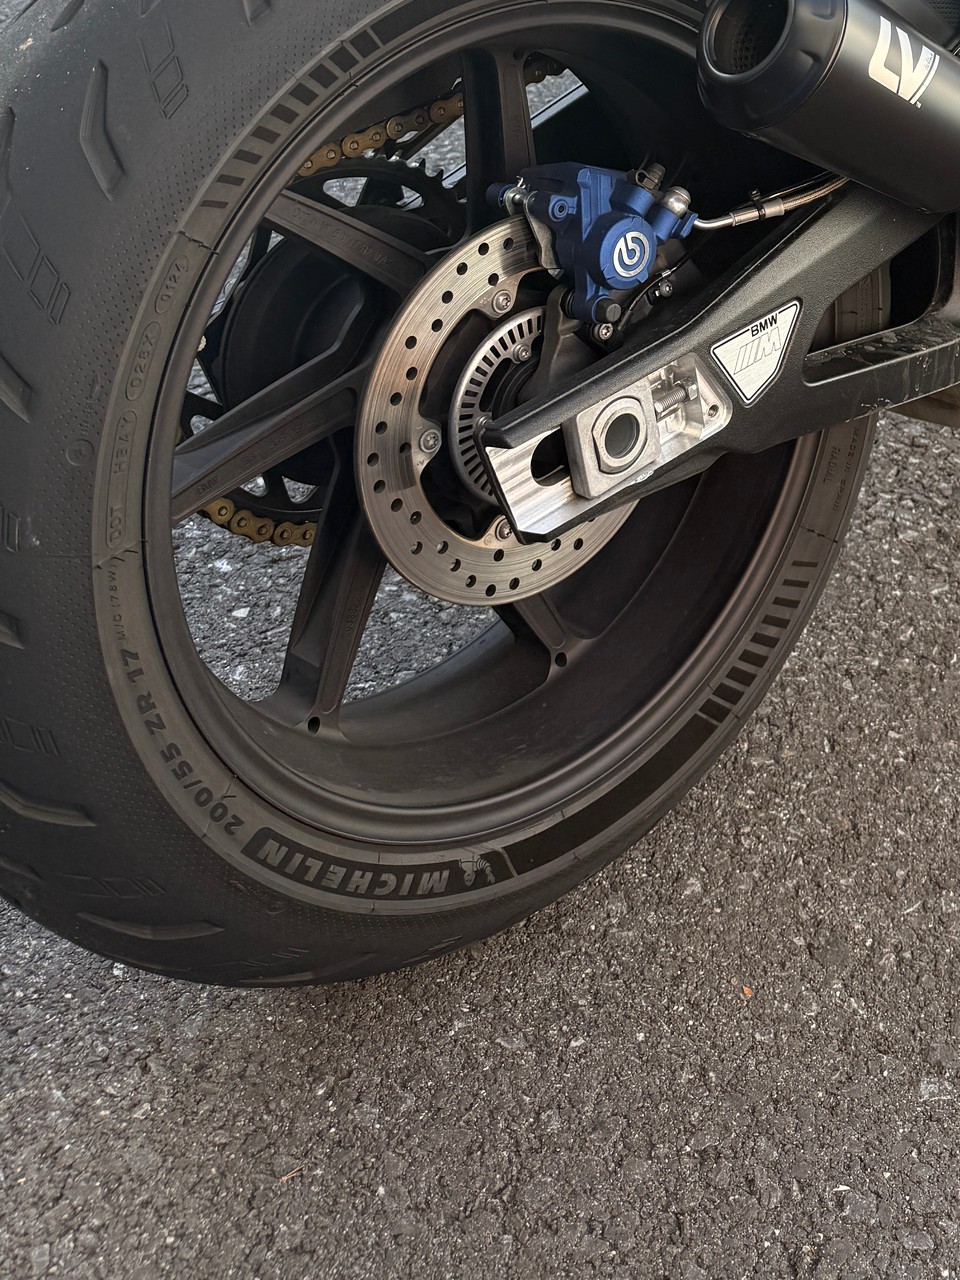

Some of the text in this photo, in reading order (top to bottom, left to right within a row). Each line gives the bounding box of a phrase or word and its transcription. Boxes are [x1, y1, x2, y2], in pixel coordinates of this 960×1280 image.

[749, 313, 778, 337] BMW
[823, 445, 841, 484] RADIAL
[120, 648, 145, 684] 17
[136, 690, 167, 736] ZR
[160, 742, 245, 836] 200/55
[257, 838, 450, 896] MICHELIN
